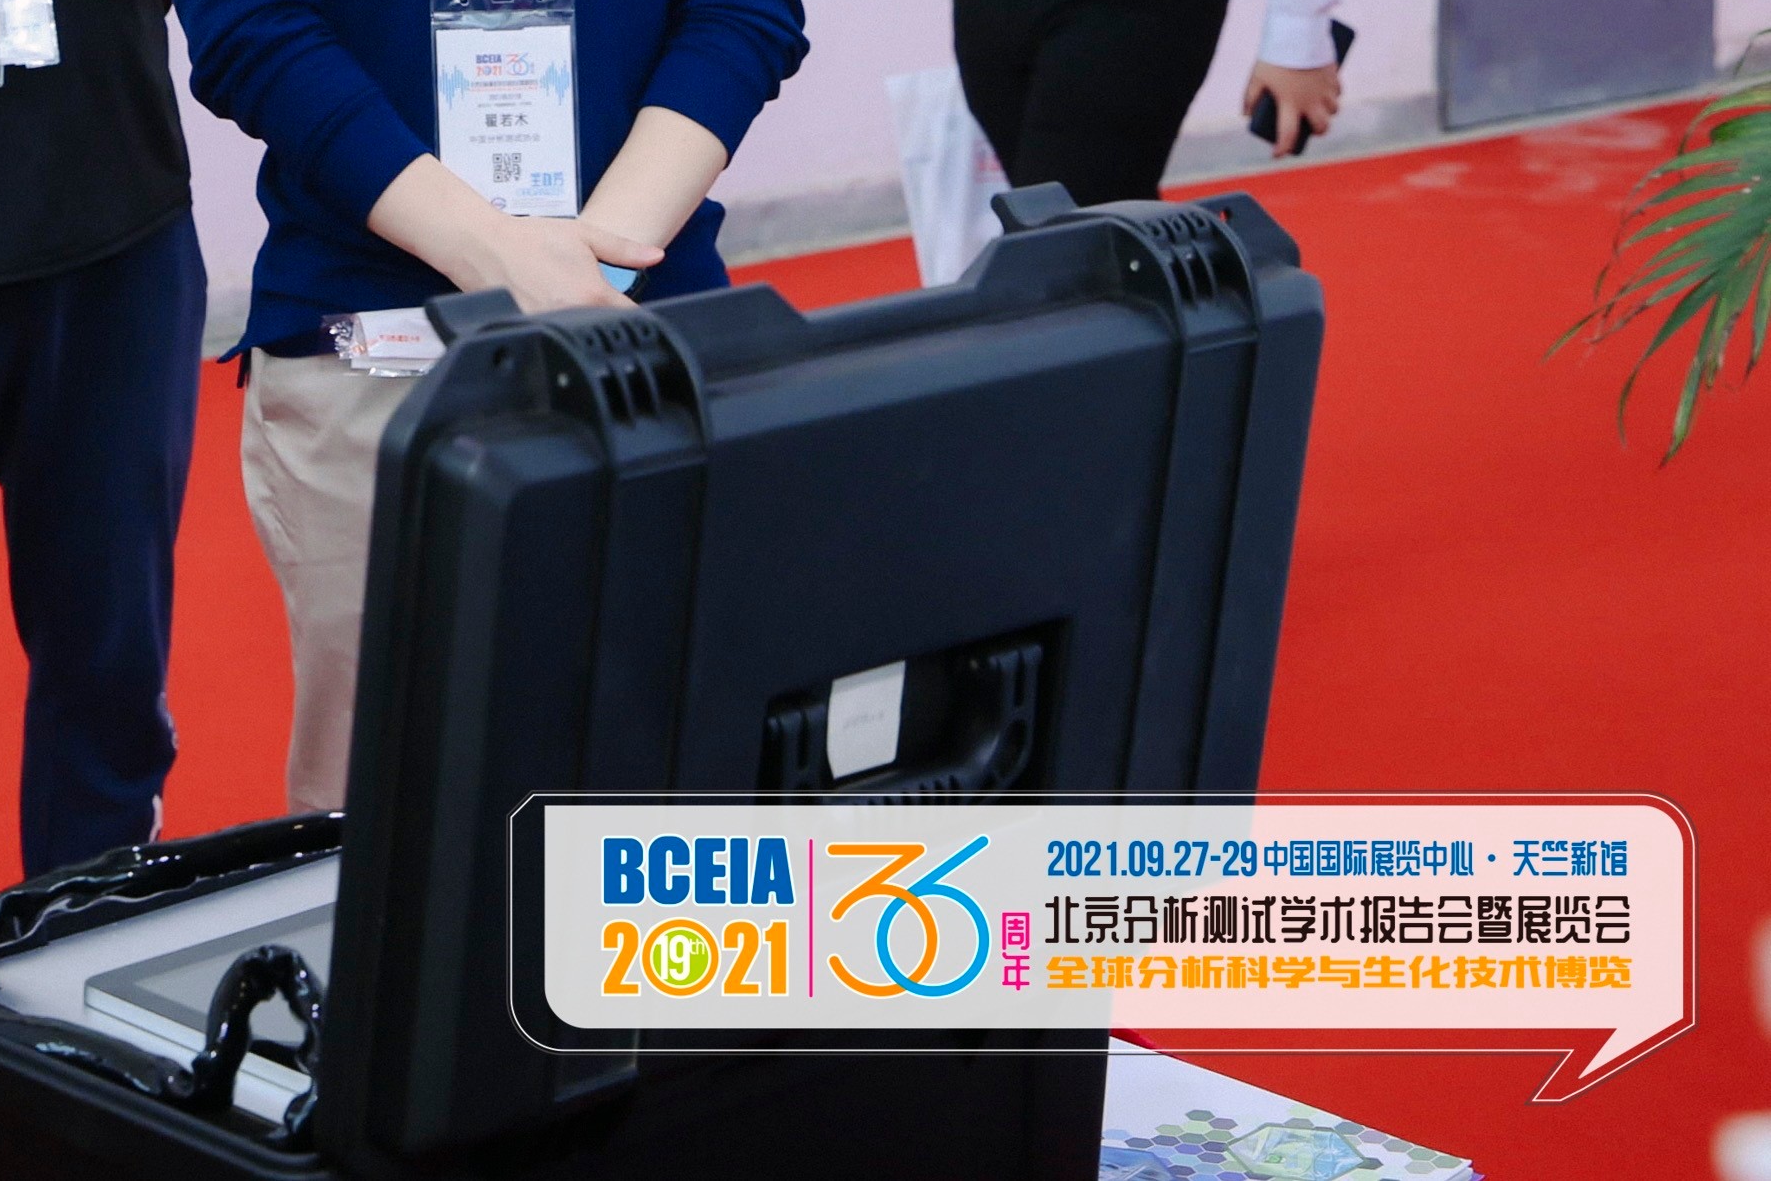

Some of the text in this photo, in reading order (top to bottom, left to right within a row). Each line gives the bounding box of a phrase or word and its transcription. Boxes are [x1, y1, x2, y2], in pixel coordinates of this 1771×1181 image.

[476, 54, 502, 64] BCEIA
[485, 113, 529, 127] 翟若木
